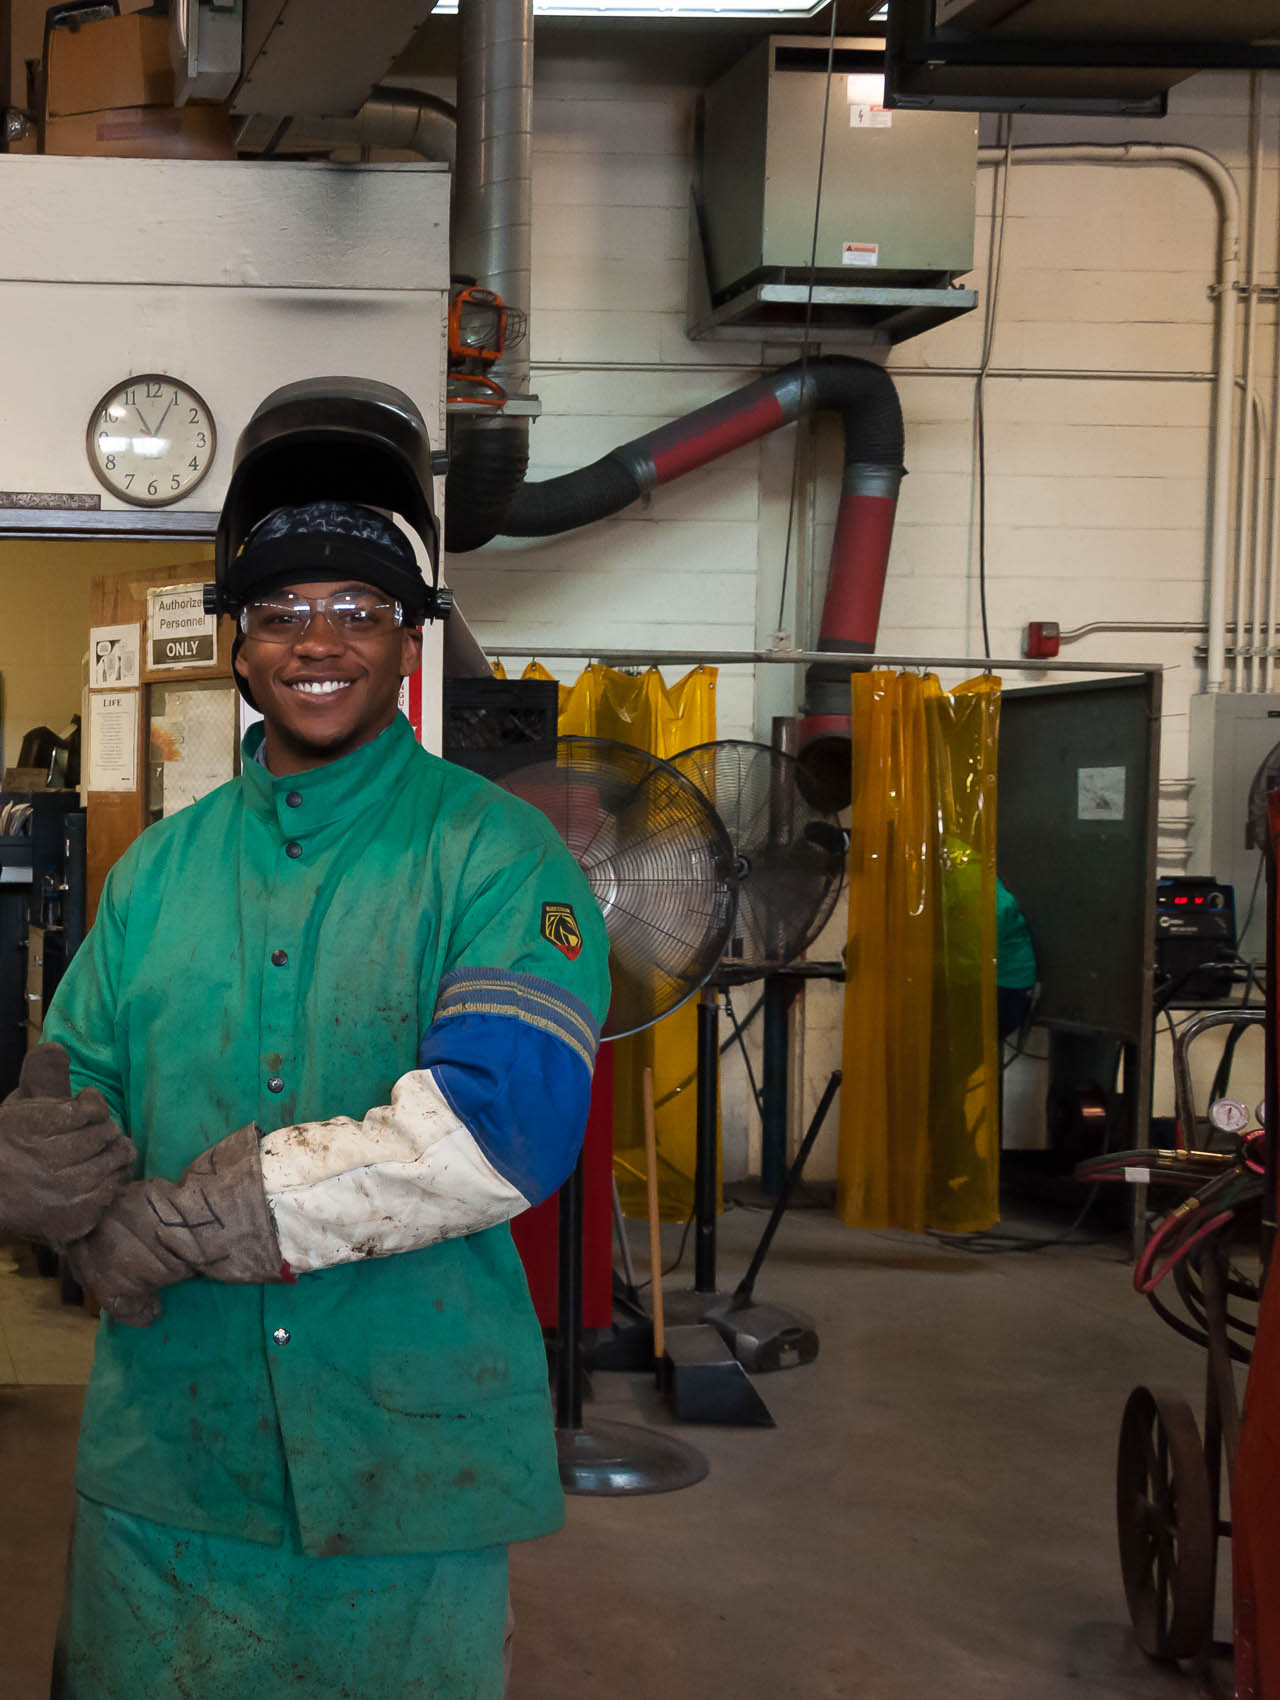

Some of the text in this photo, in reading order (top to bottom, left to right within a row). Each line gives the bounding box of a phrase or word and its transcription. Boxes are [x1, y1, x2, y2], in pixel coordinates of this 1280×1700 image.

[124, 390, 136, 406] 11
[144, 383, 163, 398] 12
[188, 408, 200, 424] 2
[196, 432, 207, 448] 3
[105, 454, 116, 471] 8
[187, 456, 200, 471] 4
[124, 474, 136, 490] 7
[147, 479, 158, 496] 6
[170, 474, 181, 490] 5
[158, 596, 203, 612] Authorize
[159, 614, 206, 631] Personnel
[166, 640, 200, 658] ONLY
[103, 698, 123, 708] LIFE
